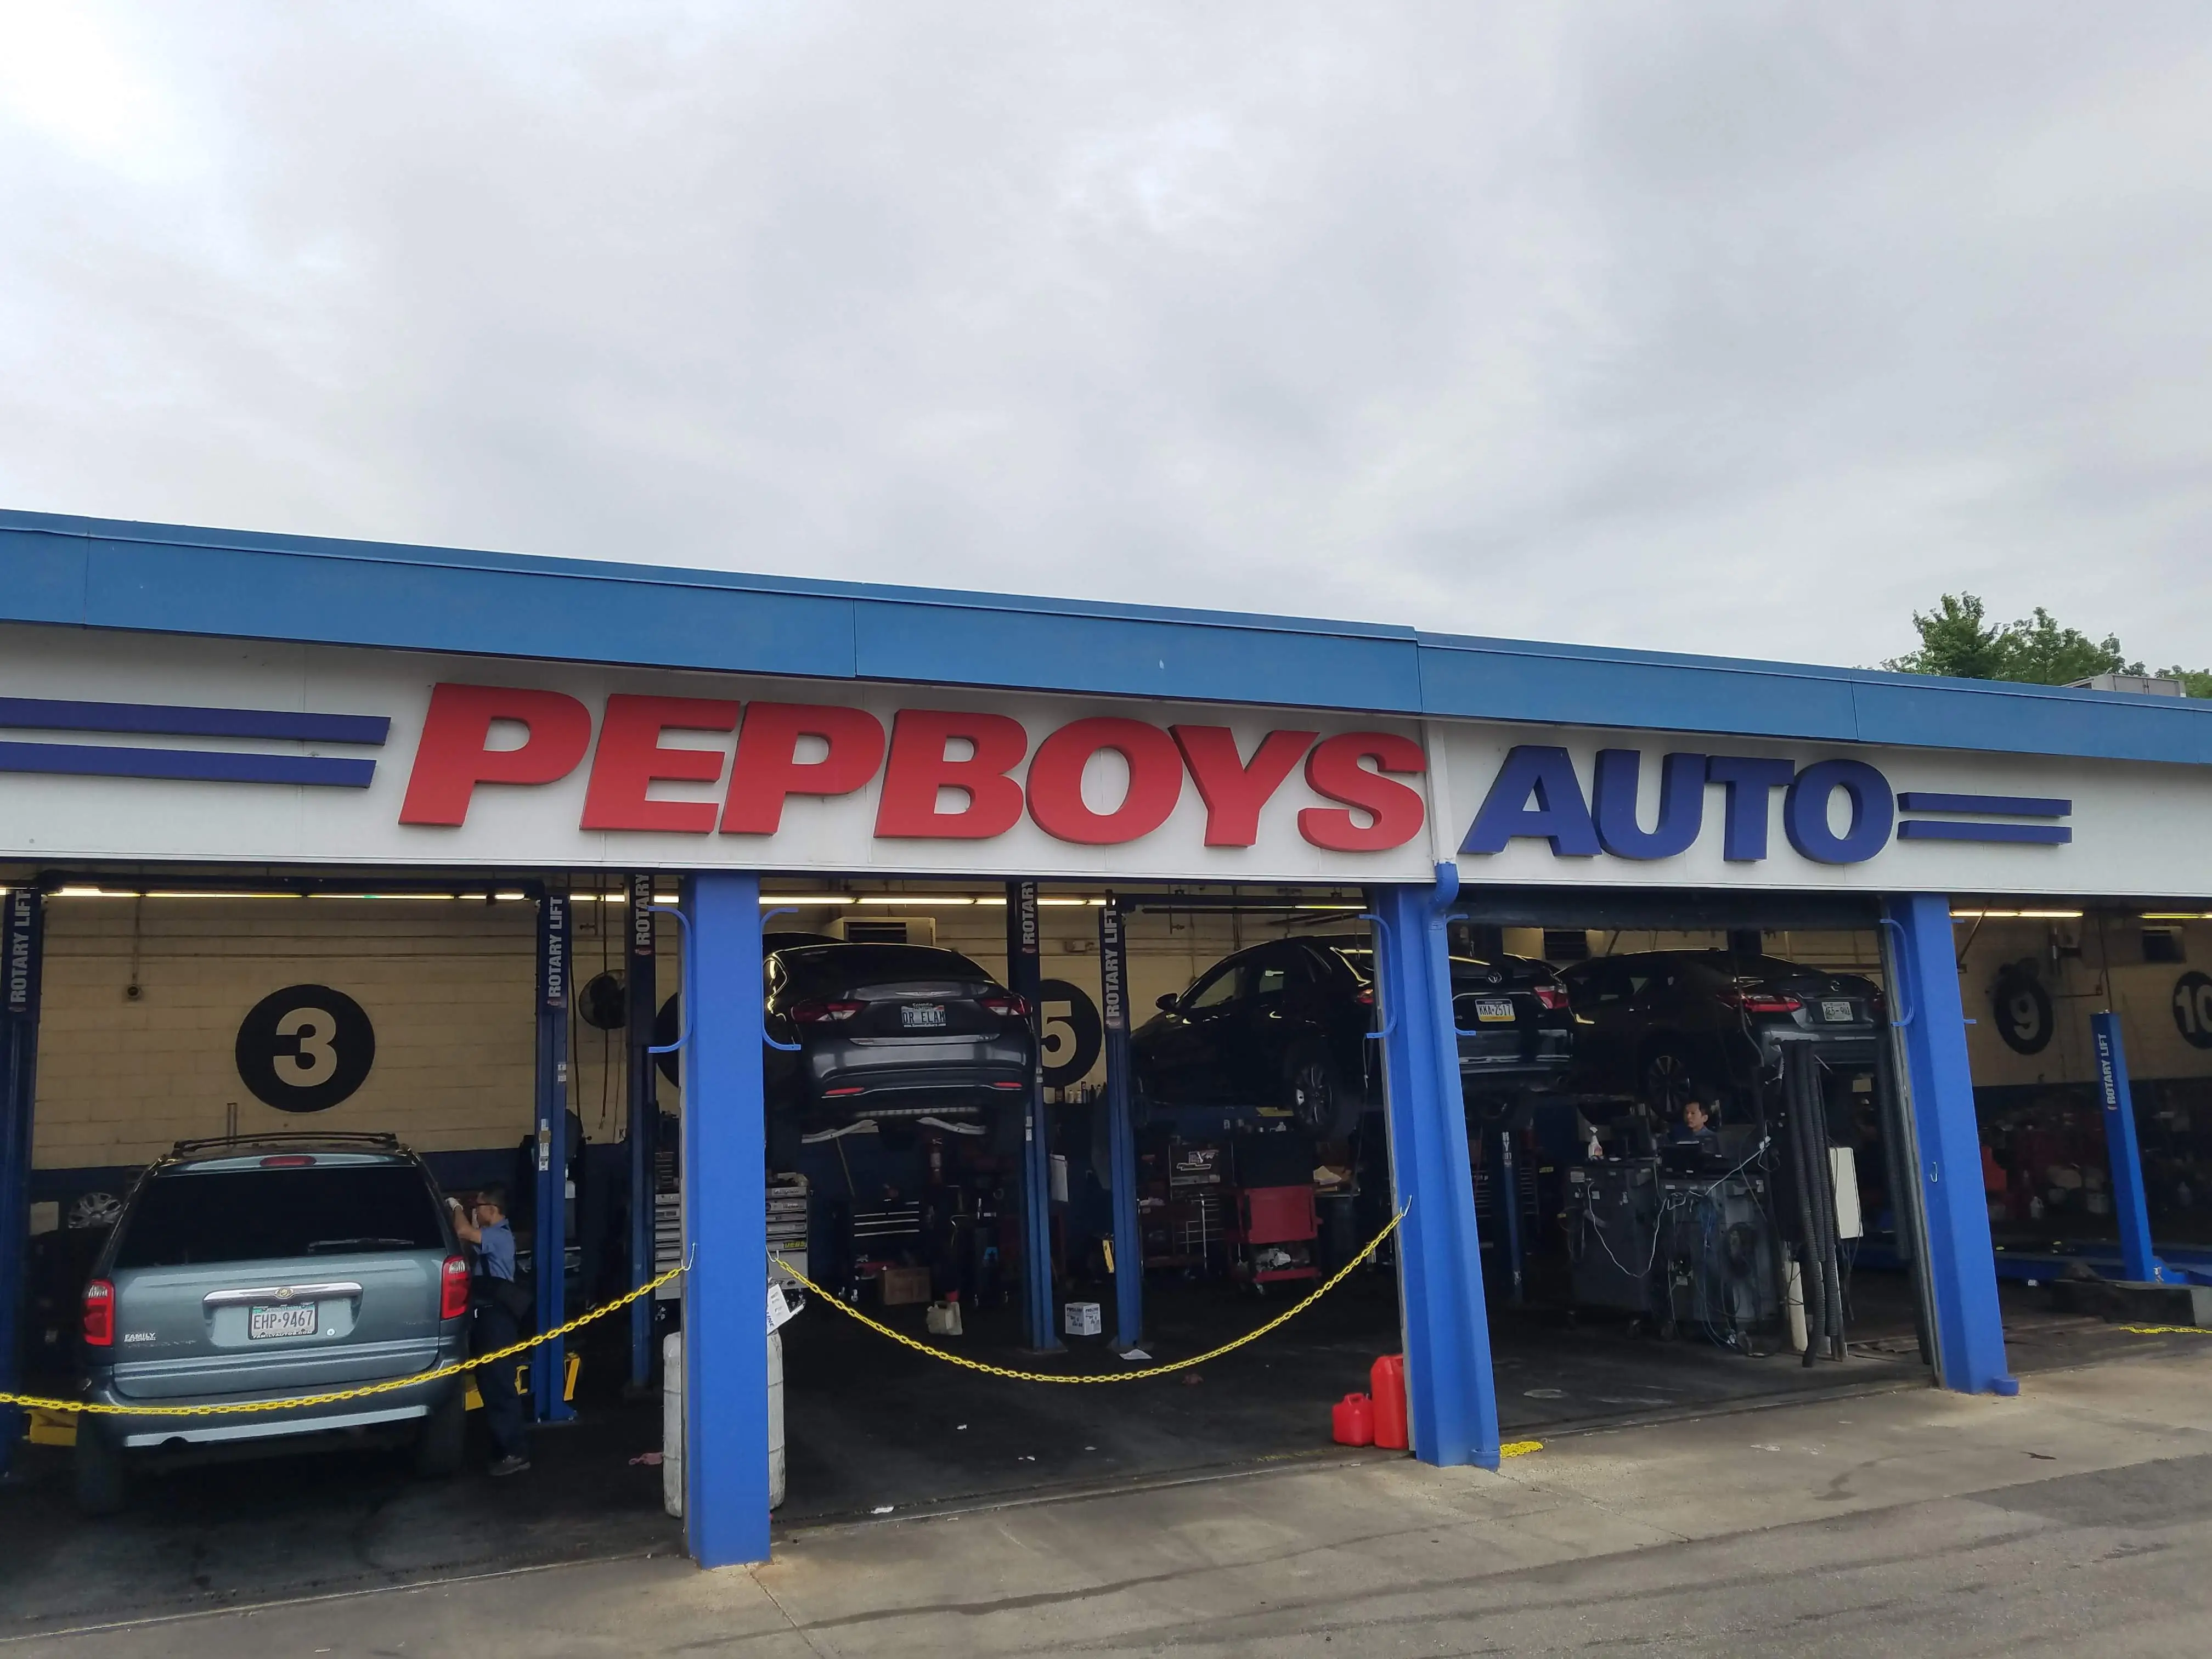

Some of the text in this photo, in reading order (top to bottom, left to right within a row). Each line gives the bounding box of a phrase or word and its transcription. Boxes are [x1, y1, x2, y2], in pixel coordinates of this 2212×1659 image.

[398, 682, 1894, 864] PEPBOYS AUTO
[10, 890, 31, 1003] ROTARY LIFT
[549, 896, 563, 997] ROTARY LIFT
[1104, 908, 1120, 1017] ROTARY LIFT
[273, 1007, 337, 1087] 3
[902, 1012, 915, 1024] DR
[1041, 1001, 1076, 1068] 5
[2009, 990, 2040, 1041] 9
[2098, 1034, 2116, 1104] ROTARY LIFT
